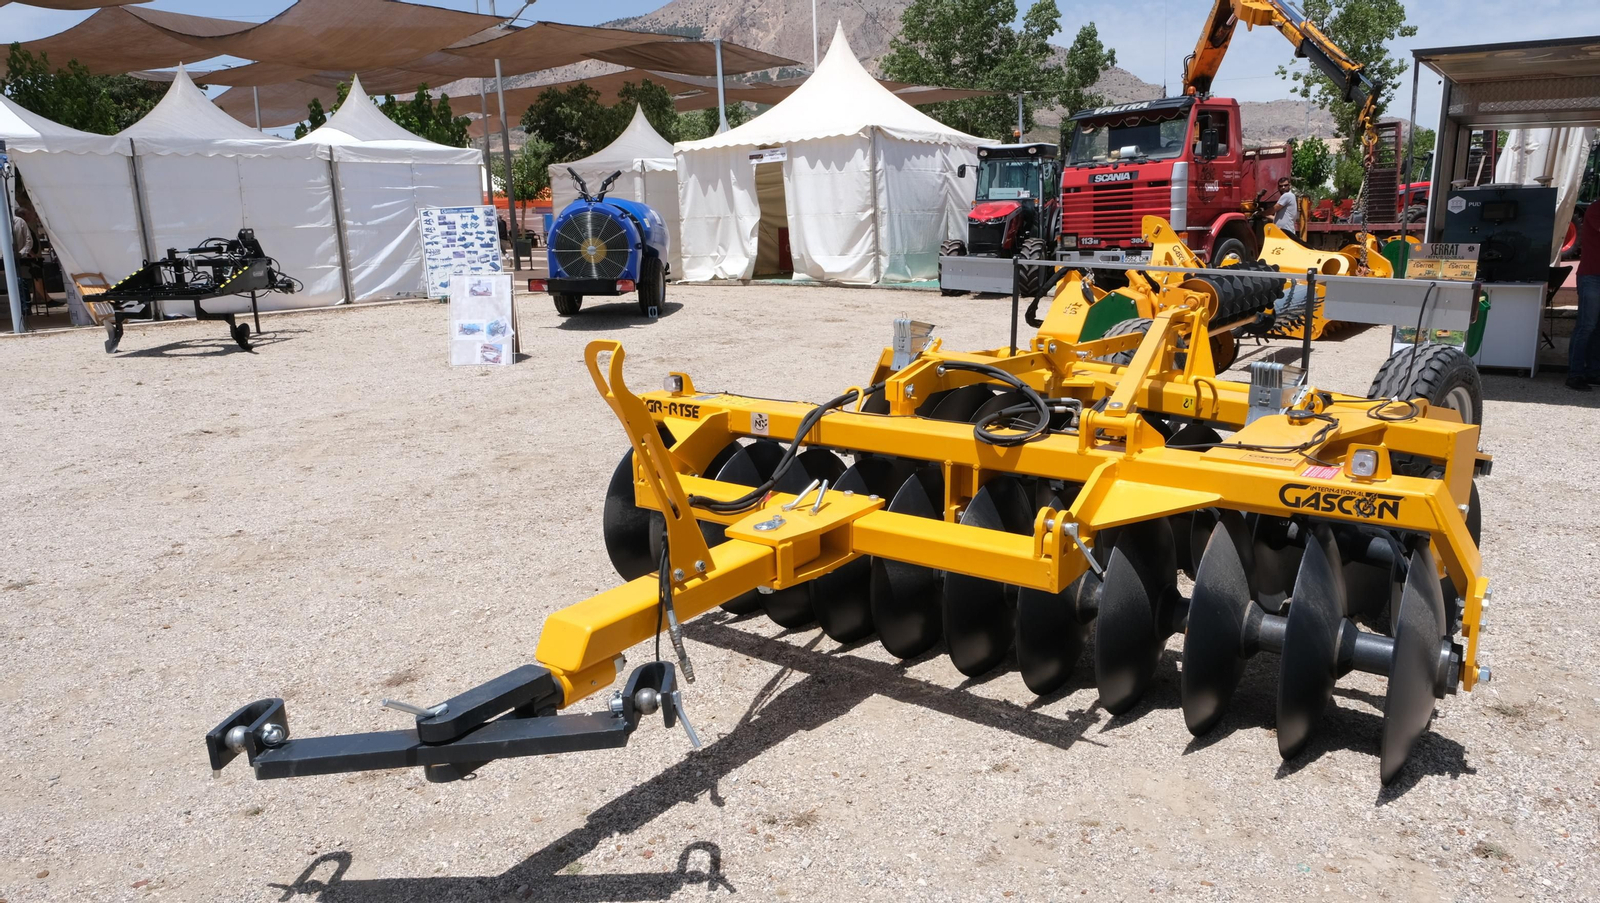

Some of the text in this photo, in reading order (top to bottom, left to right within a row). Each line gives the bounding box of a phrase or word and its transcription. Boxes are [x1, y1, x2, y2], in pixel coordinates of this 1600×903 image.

[1094, 101, 1150, 115] VALTRA
[1094, 172, 1131, 183] SCANIA
[1430, 243, 1460, 256] SERRAT
[1309, 485, 1366, 497] INTERNATIONAL
